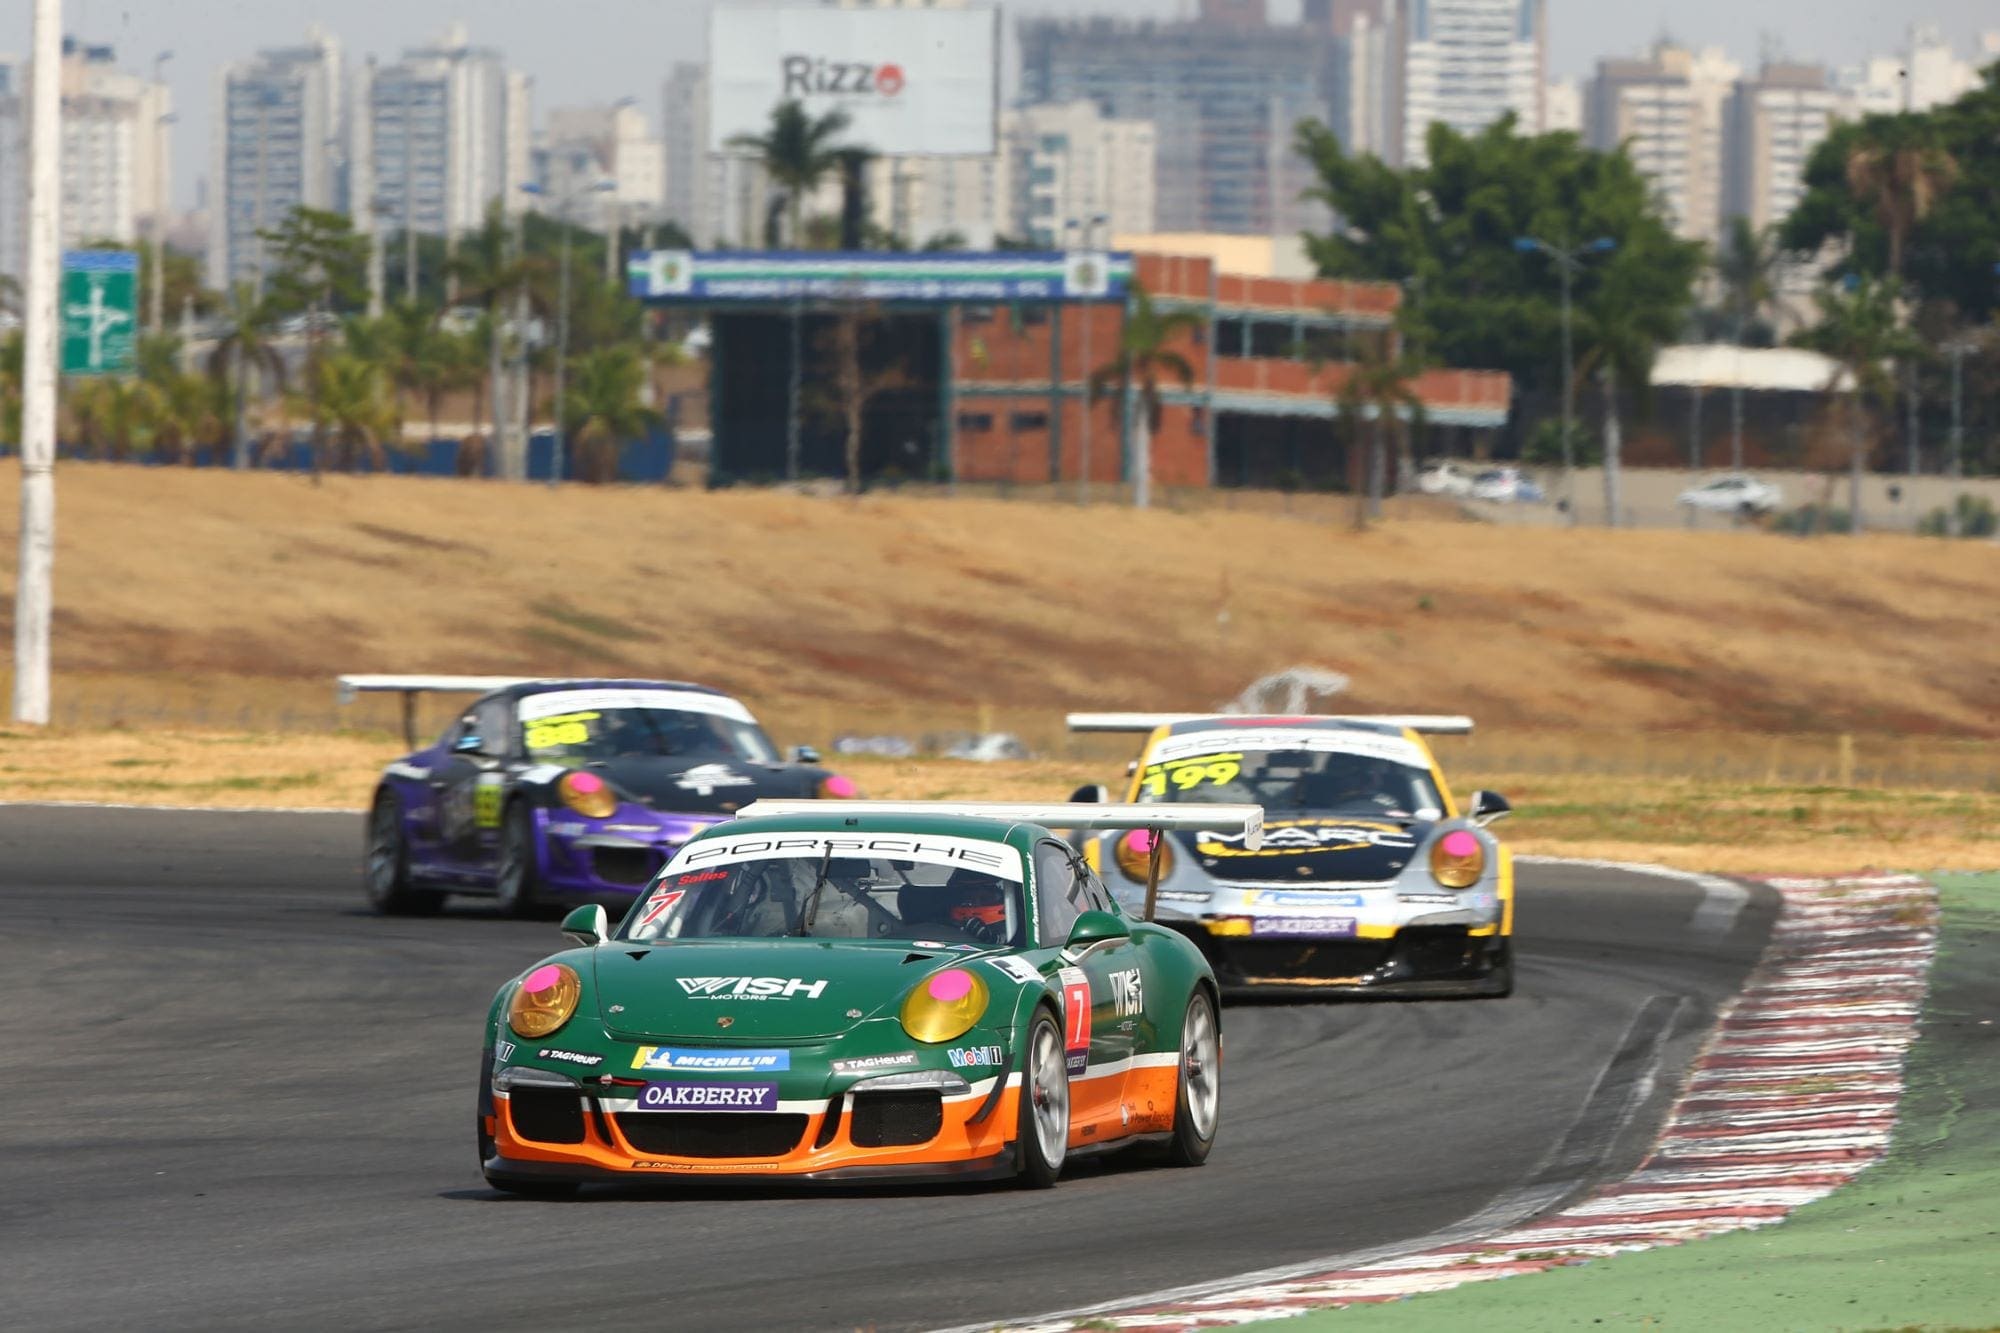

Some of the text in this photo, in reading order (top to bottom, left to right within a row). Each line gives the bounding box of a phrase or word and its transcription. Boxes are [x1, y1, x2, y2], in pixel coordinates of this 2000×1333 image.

[782, 56, 906, 97] Rizzo
[1142, 762, 1240, 796] 199
[685, 839, 1003, 868] PORSCHE
[678, 871, 729, 885] Salles
[640, 889, 686, 926] 7
[675, 977, 828, 999] WISH
[711, 993, 769, 1001] MOTORS
[1073, 990, 1083, 1043] 7
[675, 1055, 777, 1067] MICHELIN
[947, 1047, 990, 1067] Mobil
[645, 1087, 770, 1105] OAKBERRY
